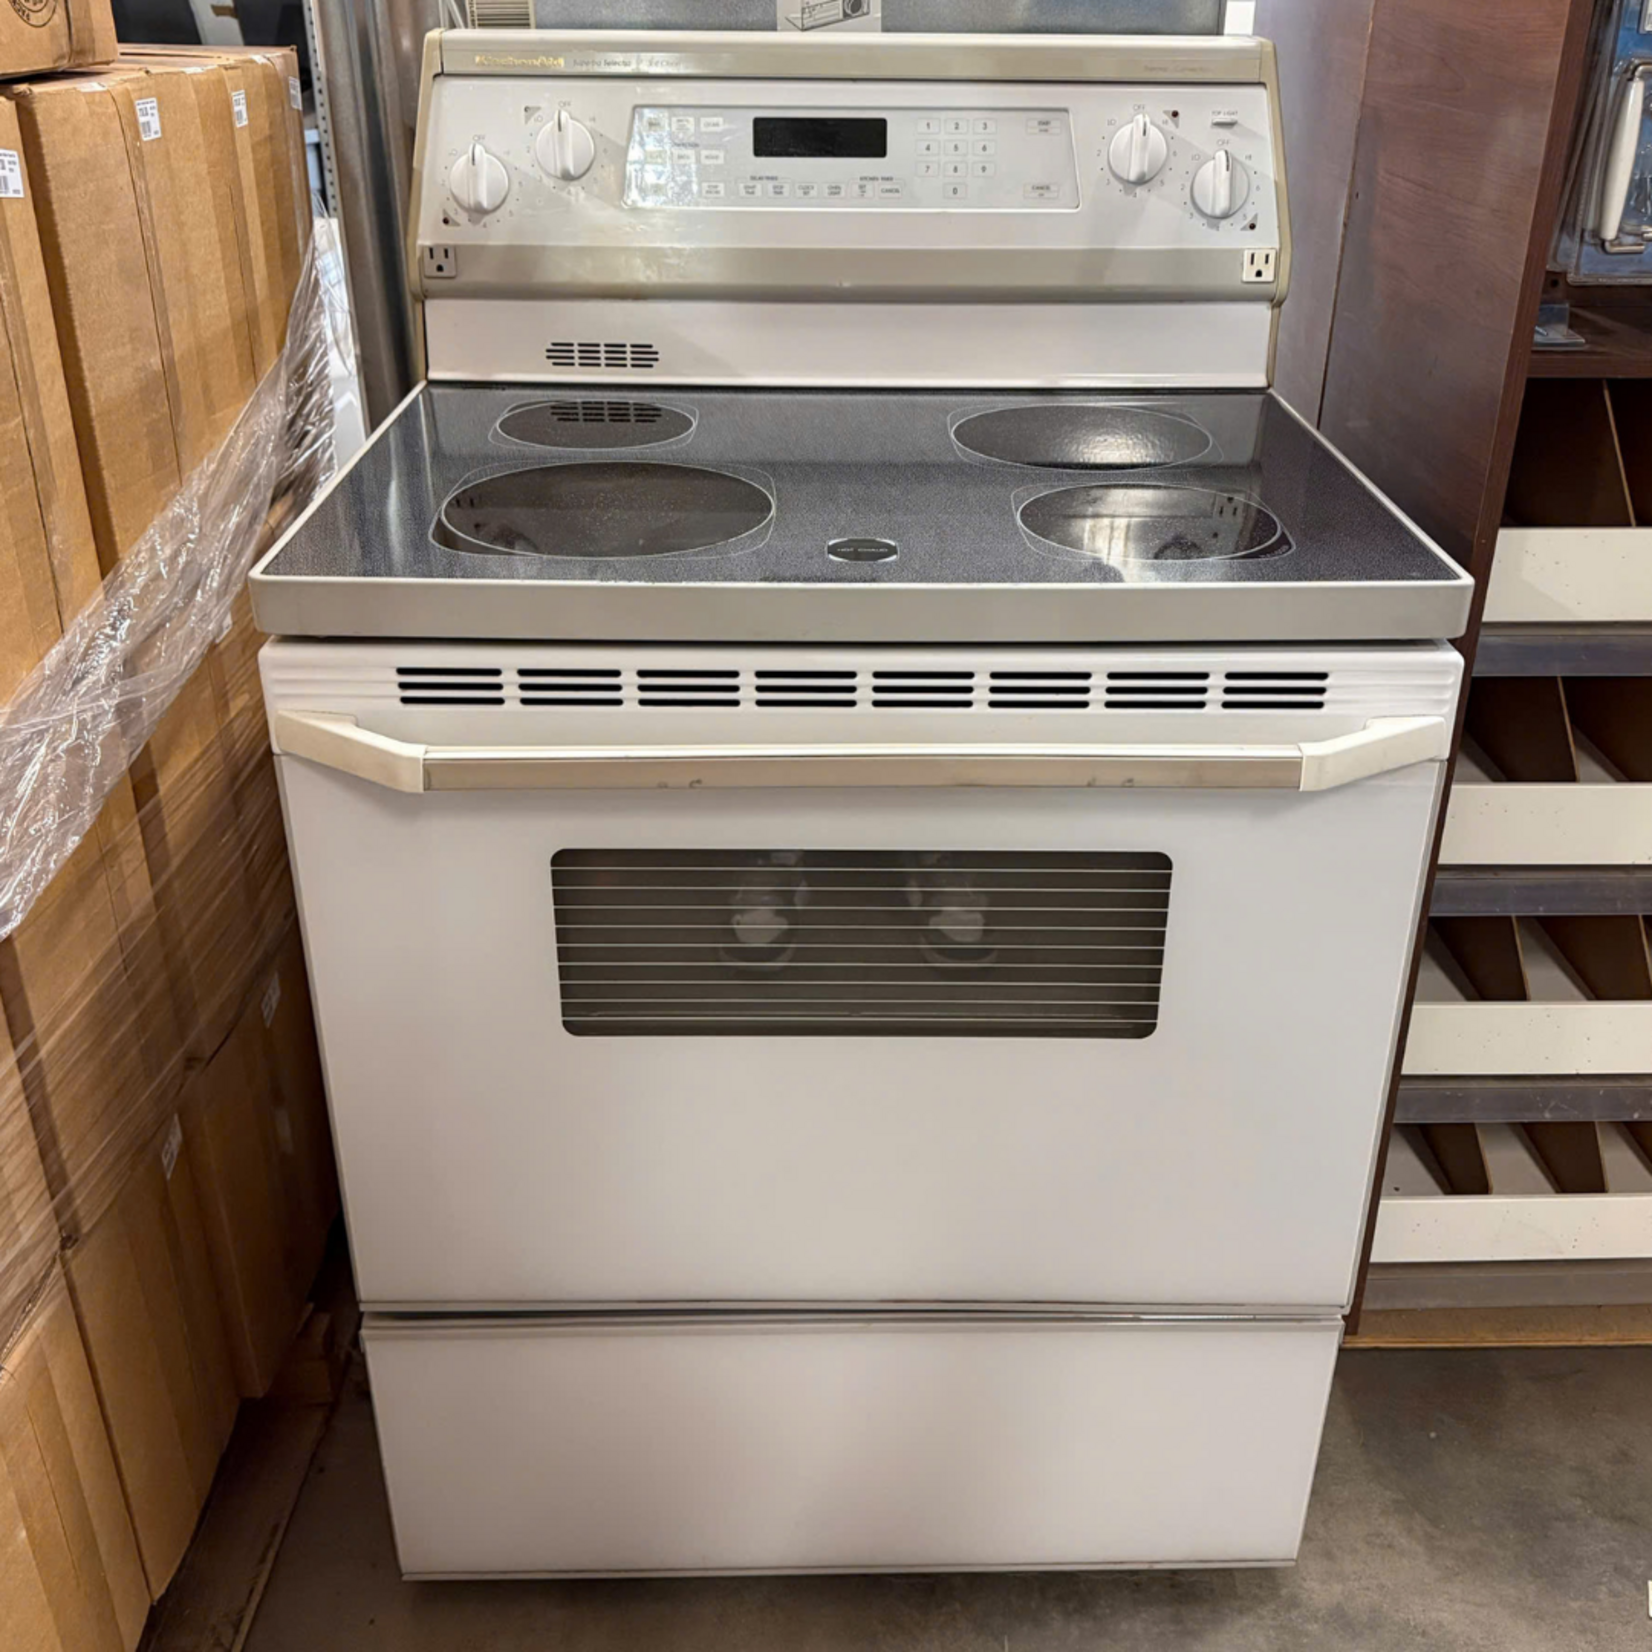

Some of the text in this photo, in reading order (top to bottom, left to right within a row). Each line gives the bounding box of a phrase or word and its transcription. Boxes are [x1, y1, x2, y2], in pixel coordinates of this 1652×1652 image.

[926, 122, 931, 130] 1
[954, 122, 959, 130] 2
[982, 122, 987, 130] 3
[925, 144, 931, 152] 4
[953, 144, 959, 152] 5
[981, 144, 987, 152] 6
[953, 166, 958, 174] 8
[952, 187, 958, 195] 0
